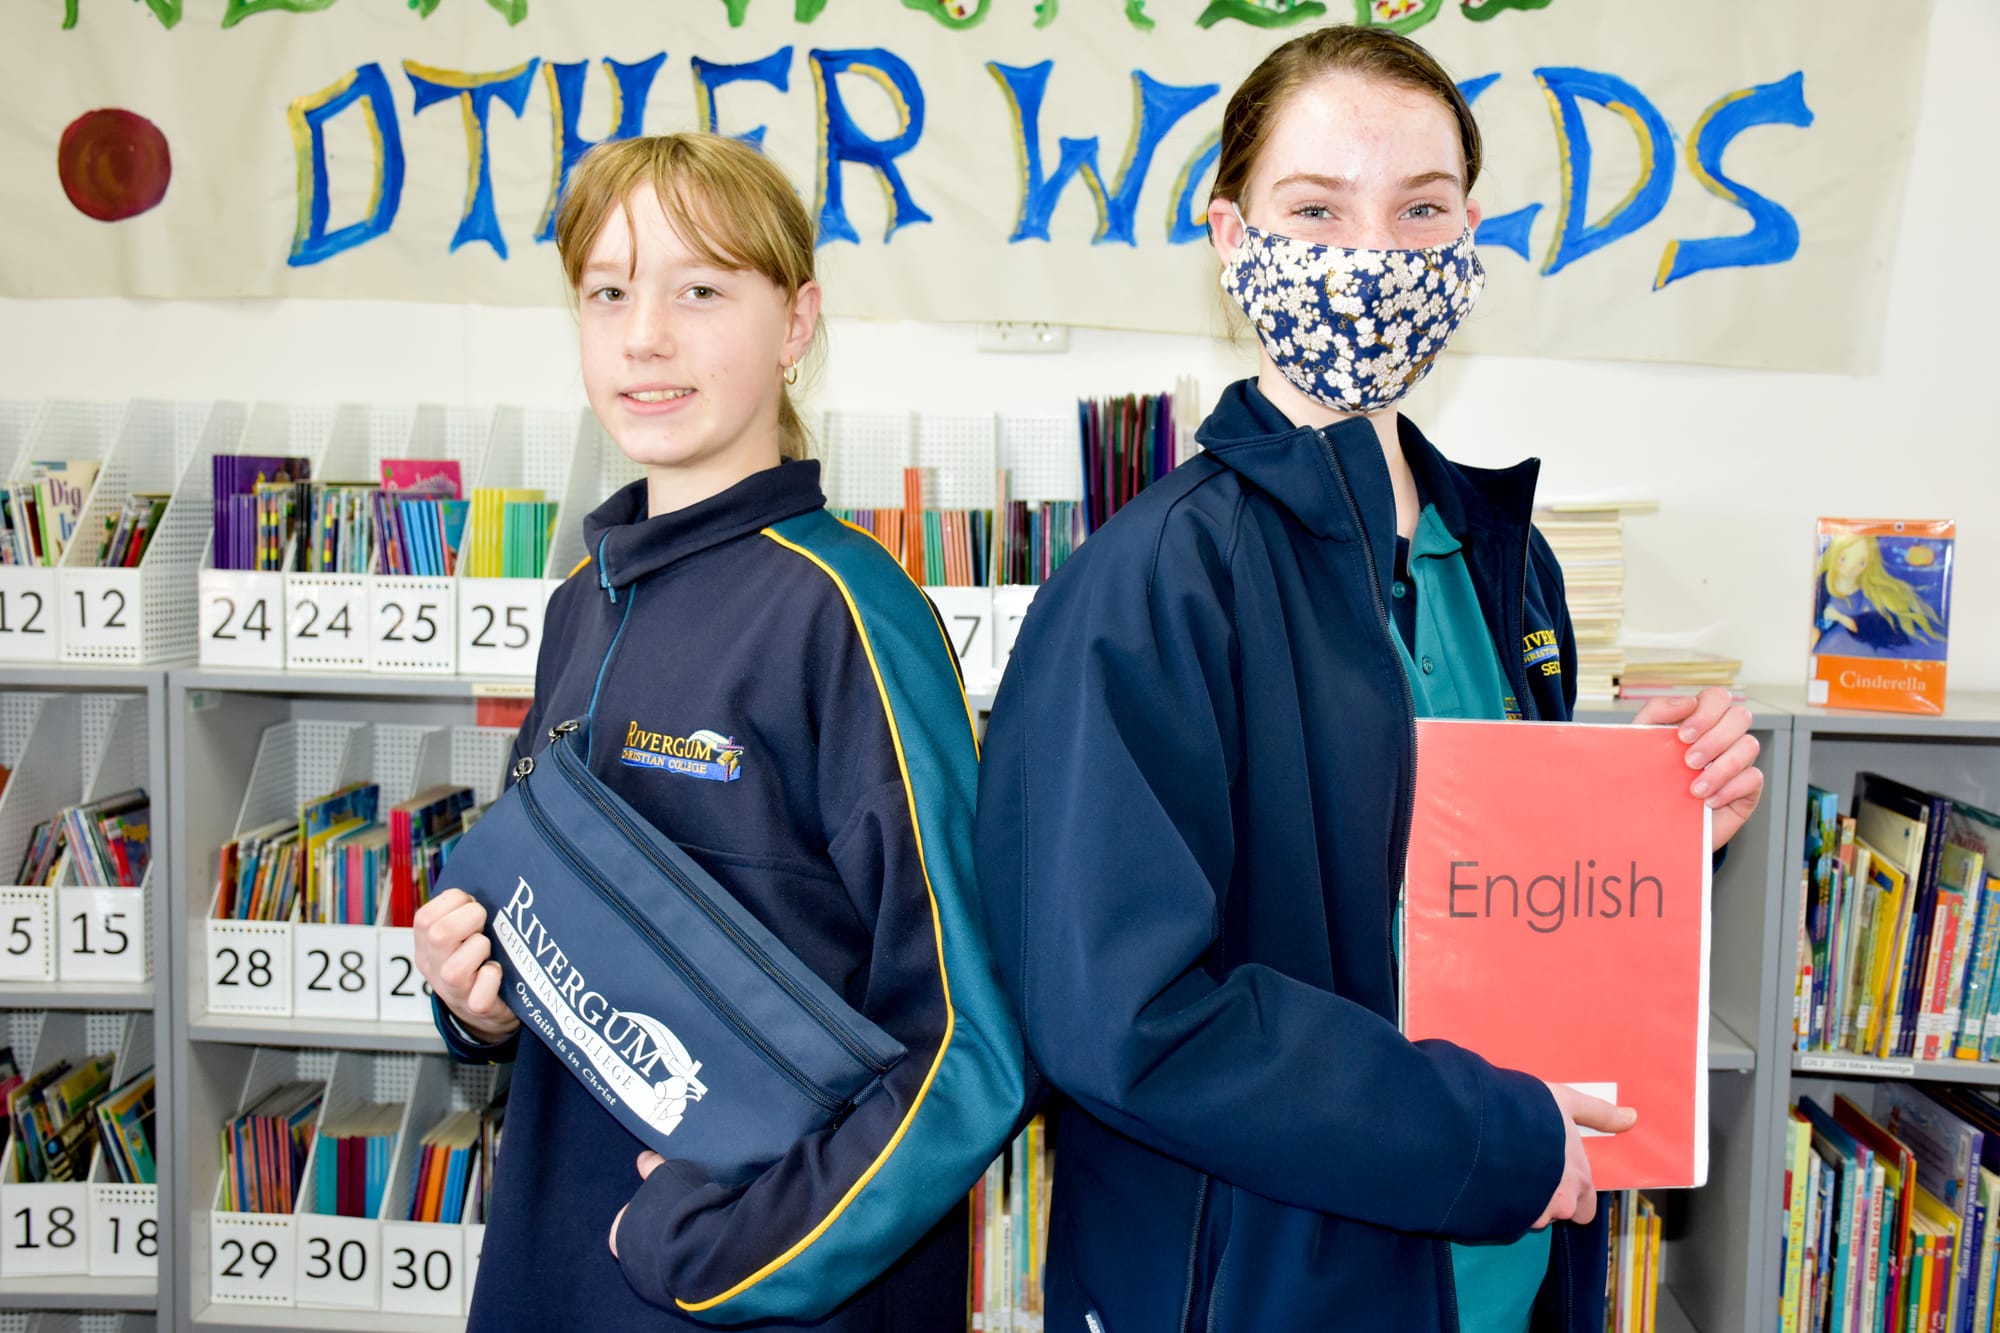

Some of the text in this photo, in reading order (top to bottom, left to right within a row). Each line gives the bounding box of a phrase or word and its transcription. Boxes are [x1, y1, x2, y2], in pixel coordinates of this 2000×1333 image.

[48, 477, 83, 517] Dig
[0, 591, 46, 633] 12
[74, 589, 127, 629] 12
[212, 598, 272, 642] 24
[296, 599, 353, 638] 24
[381, 602, 438, 643] 25
[471, 604, 530, 649] 25
[1839, 670, 1927, 693] Cinderella
[624, 720, 712, 761] RIVERGUM
[668, 758, 708, 774] COLLEGE
[1448, 860, 1664, 934] English
[7, 916, 32, 956] 5
[72, 912, 130, 956] 15
[216, 947, 273, 988] 28
[307, 949, 366, 993] 28
[502, 875, 669, 1078] RIVERGUM
[499, 920, 637, 1091] CHRISTIAN COLLEGE
[515, 981, 618, 1107] Our faith is in Christ
[1873, 1184, 1883, 1217] TRUCKS
[14, 1206, 76, 1249] 18
[109, 1216, 157, 1258] 18
[220, 1238, 278, 1280] 29
[305, 1236, 368, 1282] 30
[392, 1247, 453, 1291] 30
[1868, 1250, 1879, 1281] WORLD
